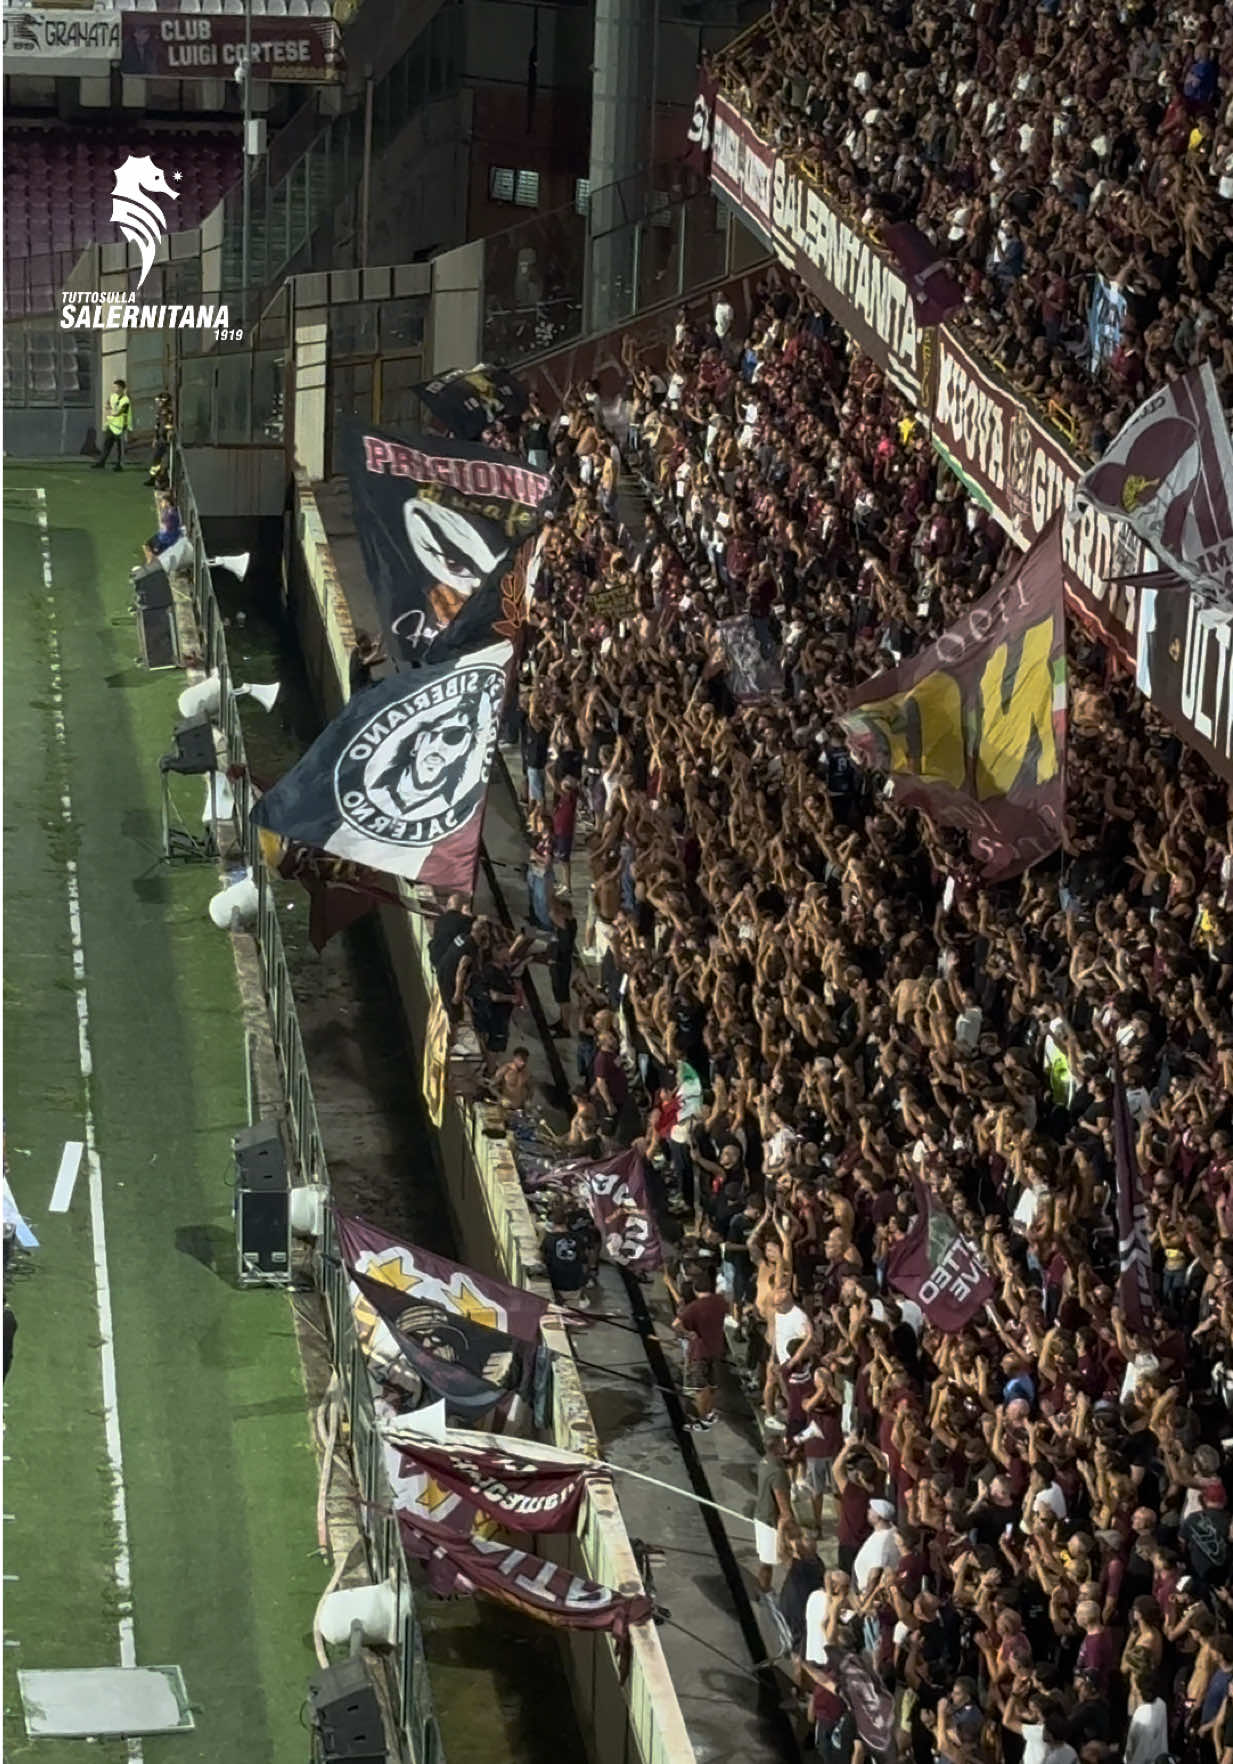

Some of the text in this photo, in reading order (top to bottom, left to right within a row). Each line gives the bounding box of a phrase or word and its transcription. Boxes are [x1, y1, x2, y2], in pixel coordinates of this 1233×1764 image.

[45, 20, 120, 47] GRANATA
[161, 19, 211, 41] CLUB
[168, 40, 311, 66] LUIGI CORTESE
[1181, 592, 1233, 758] ULT
